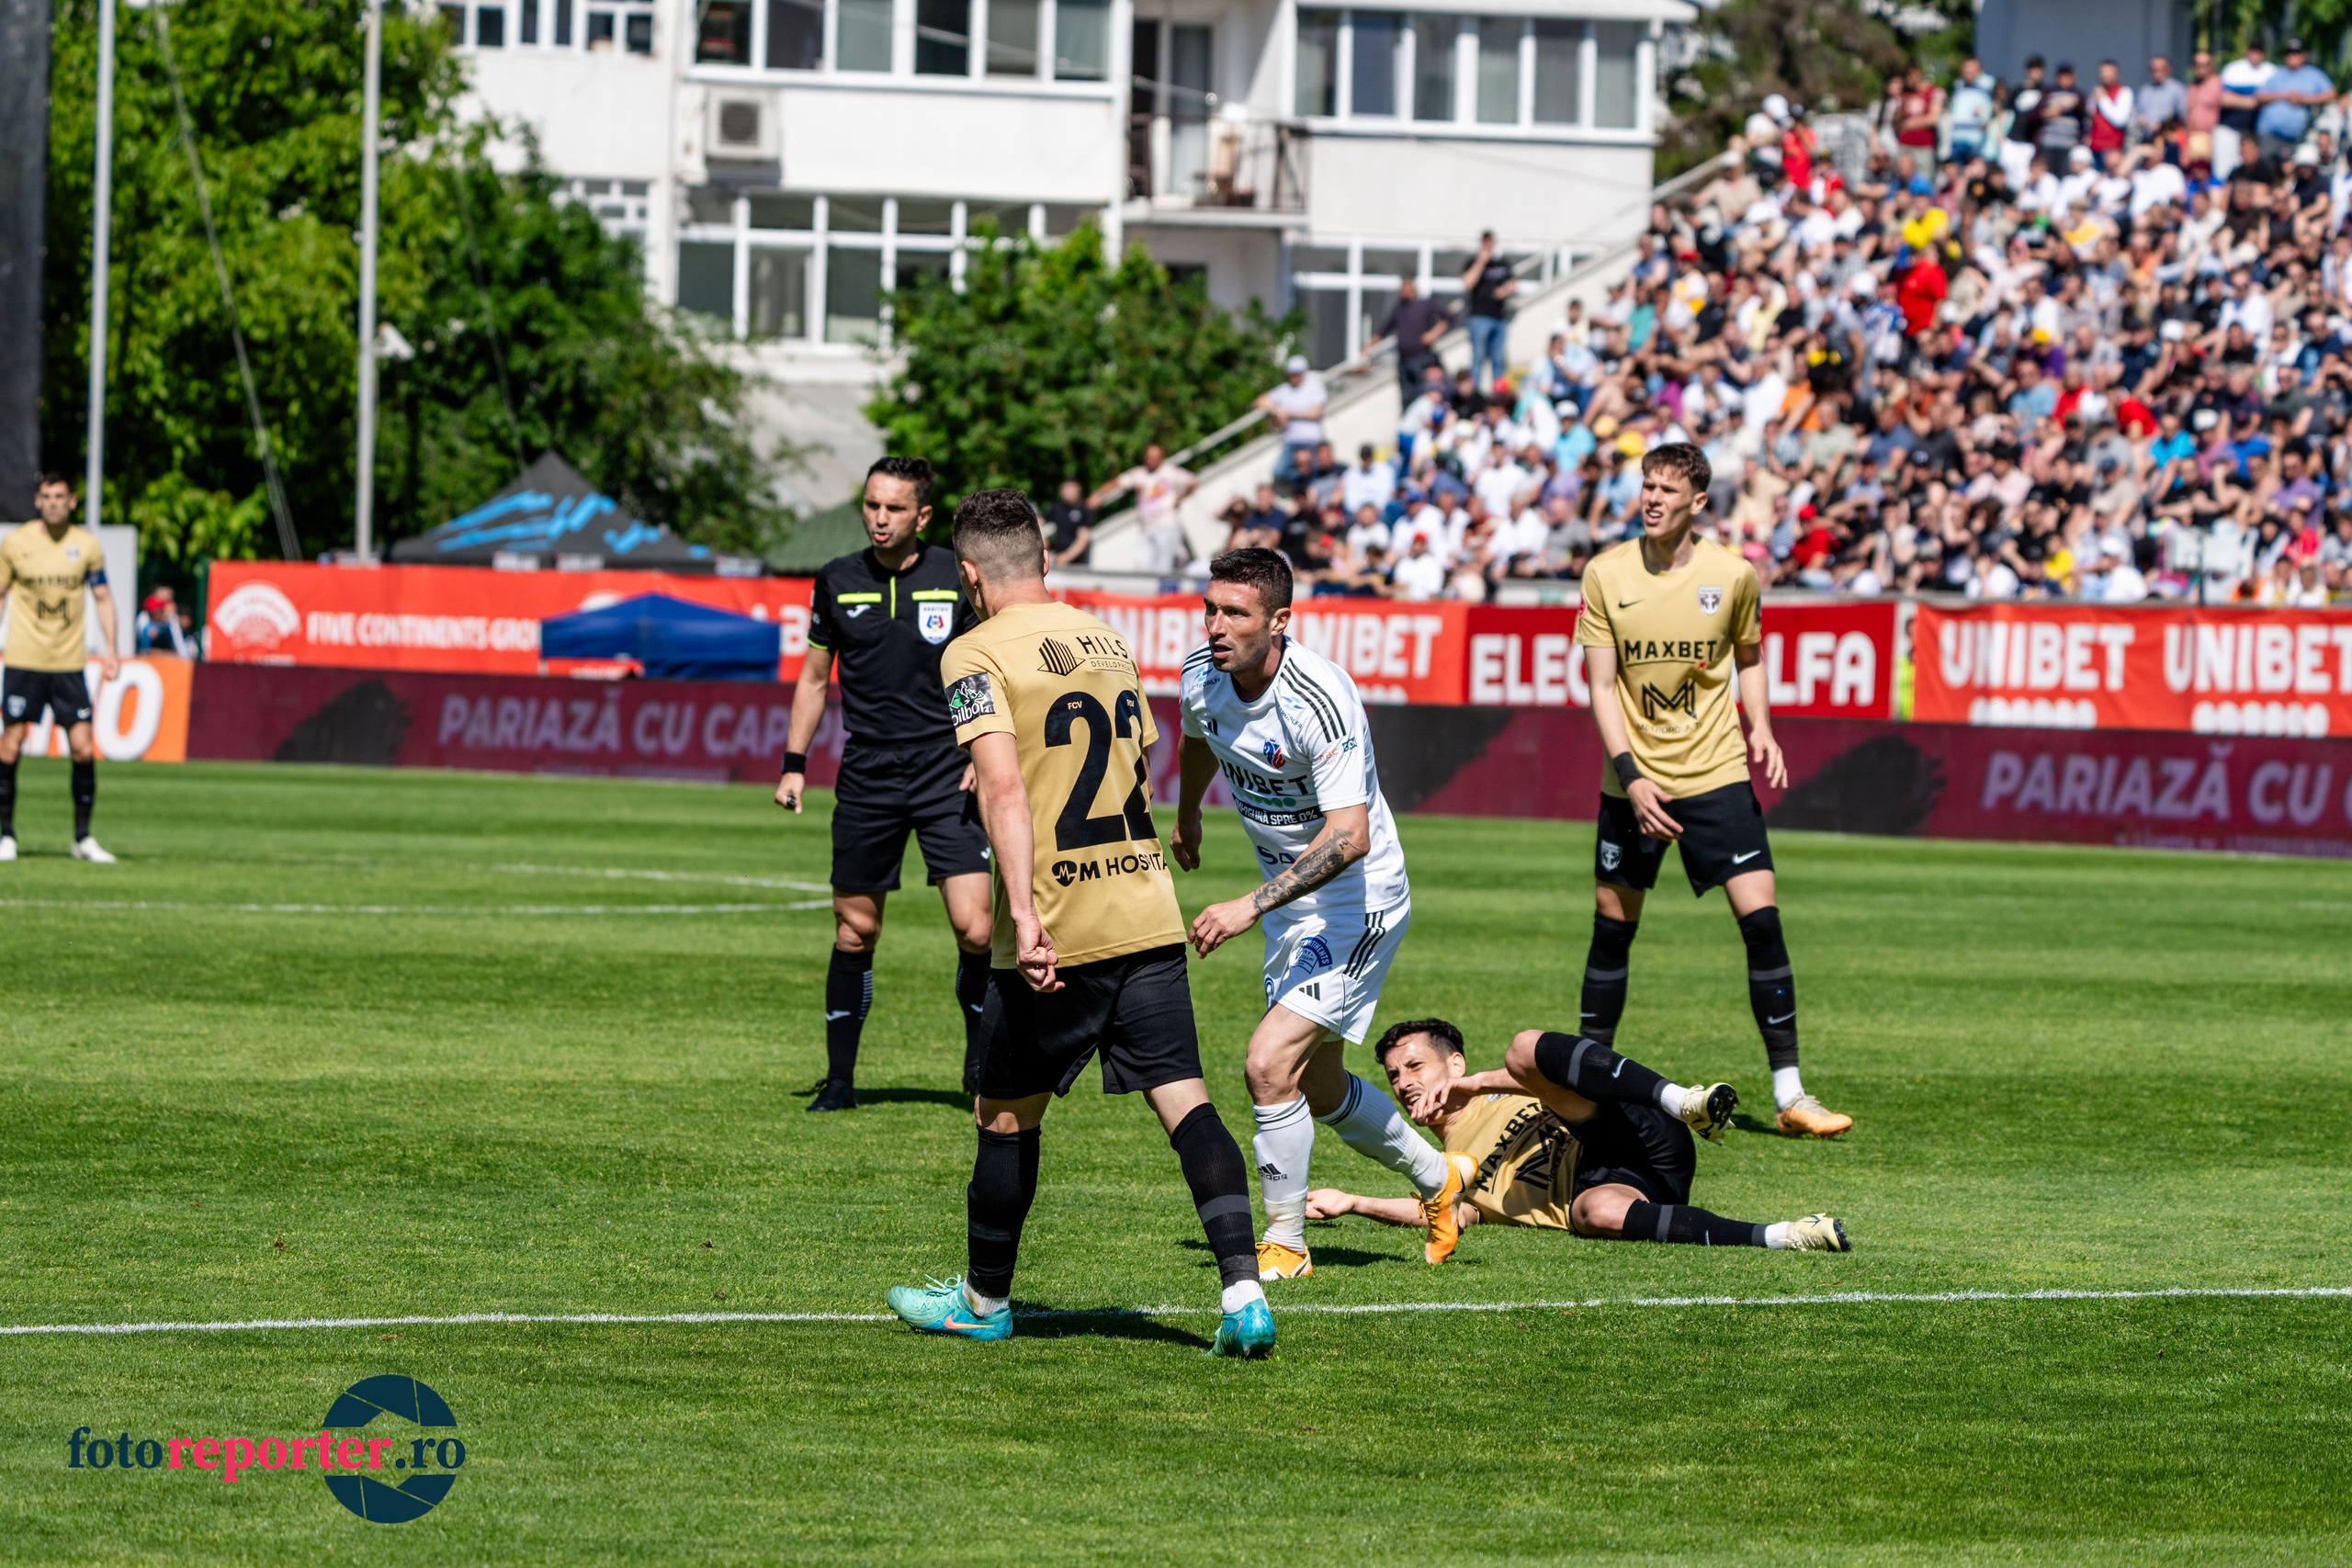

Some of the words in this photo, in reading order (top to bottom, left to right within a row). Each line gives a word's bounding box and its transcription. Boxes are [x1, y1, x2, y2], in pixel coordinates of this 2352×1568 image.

[1076, 636, 1128, 659] HILS
[1624, 639, 1717, 662] MAXBET
[1940, 620, 2134, 691] UNIBET
[1068, 701, 1082, 710] FCV
[632, 704, 695, 755] CU
[1045, 689, 1158, 852] 22
[1982, 742, 2235, 821] PARIAZĂ
[2247, 761, 2334, 825] CU
[1271, 814, 1297, 825] SPRE
[1298, 809, 1317, 822] 0%
[1079, 861, 1101, 882] M
[1475, 1102, 1548, 1192] MAXBET
